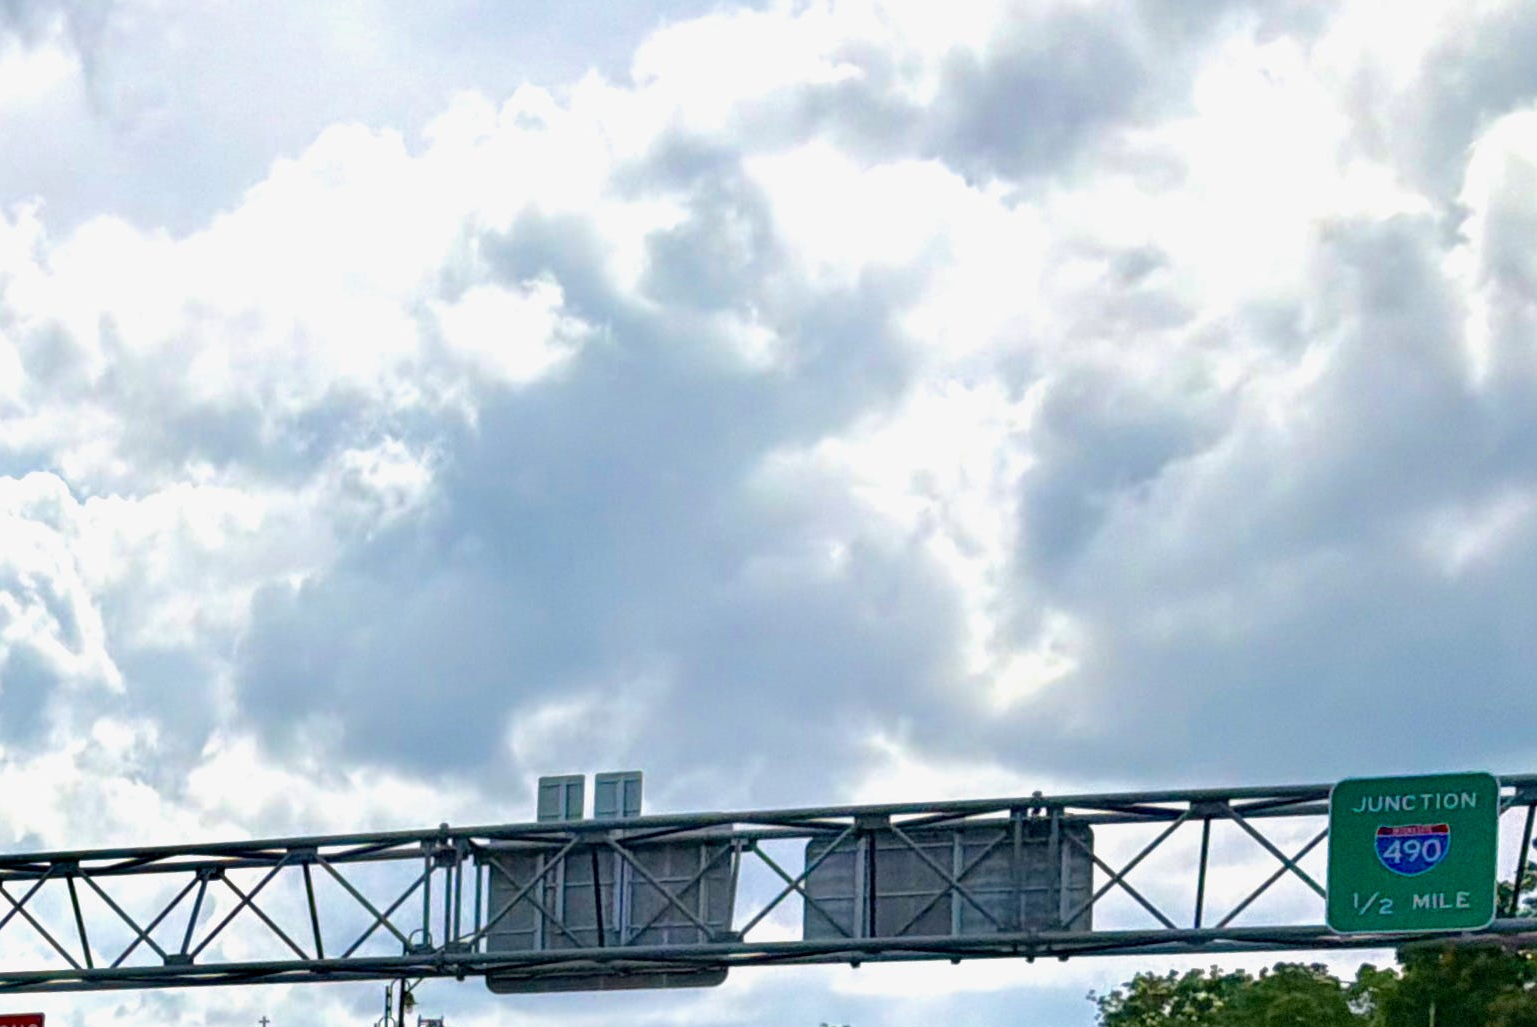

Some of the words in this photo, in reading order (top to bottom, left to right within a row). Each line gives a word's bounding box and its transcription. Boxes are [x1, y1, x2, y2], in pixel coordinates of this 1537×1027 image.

[1352, 792, 1477, 813] JUNCTION
[1382, 838, 1442, 864] 490
[1353, 891, 1394, 916] 1/2
[1412, 891, 1471, 910] MILE
